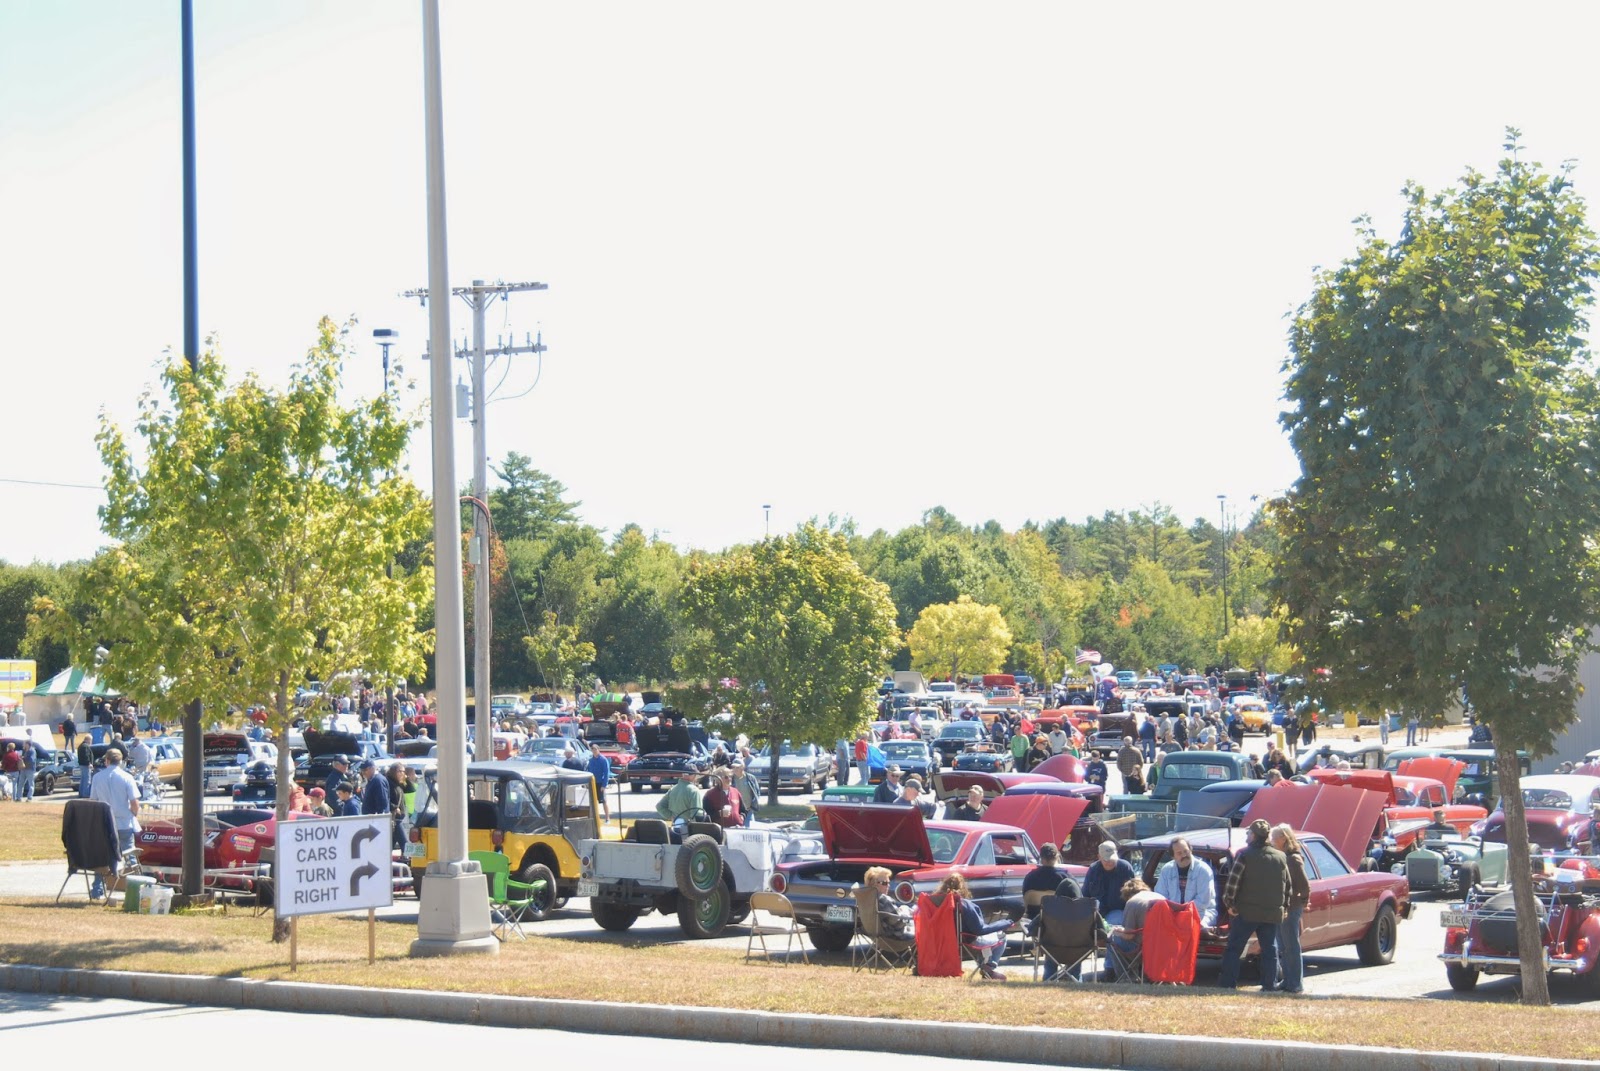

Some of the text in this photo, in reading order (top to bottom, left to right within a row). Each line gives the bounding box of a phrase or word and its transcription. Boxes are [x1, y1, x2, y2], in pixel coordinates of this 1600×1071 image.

[295, 826, 339, 842] SHOW
[296, 847, 337, 862] CARS
[296, 867, 336, 883] TURN
[294, 887, 339, 904] RIGHT
